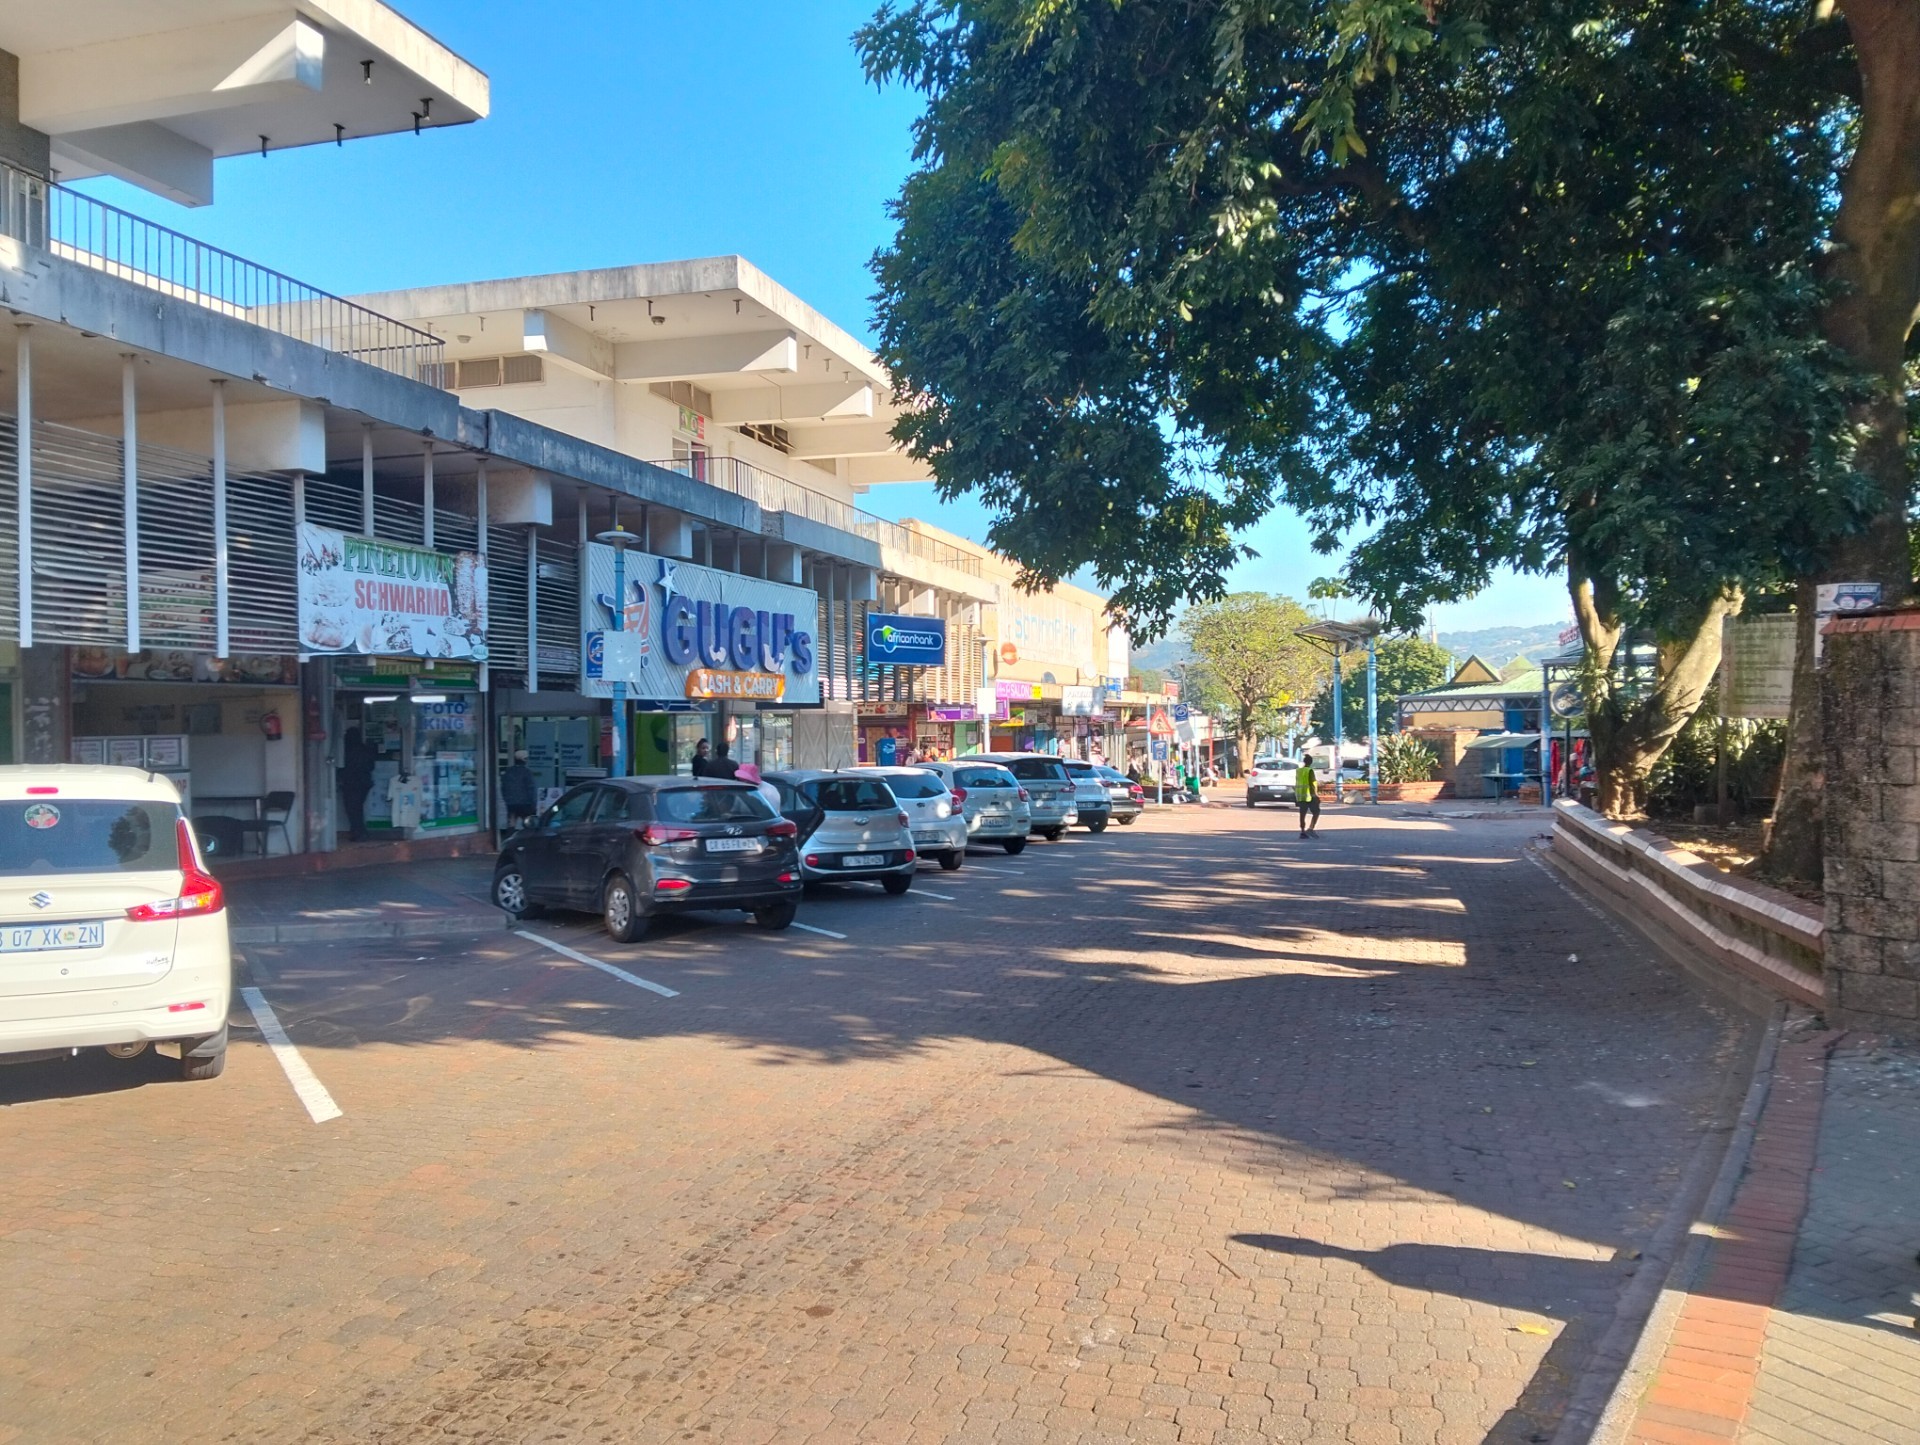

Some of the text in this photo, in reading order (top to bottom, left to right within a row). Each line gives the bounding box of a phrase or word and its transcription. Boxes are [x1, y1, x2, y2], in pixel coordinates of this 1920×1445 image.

[343, 536, 455, 584] PINETOWN
[355, 579, 450, 616] SCHWARMA
[886, 633, 934, 647] africanbank
[700, 672, 778, 698] CASH & CARRY
[423, 702, 465, 714] FOTO
[423, 717, 465, 730] KING
[12, 929, 33, 947] 07
[43, 927, 62, 945] XK
[78, 926, 99, 944] ZN
